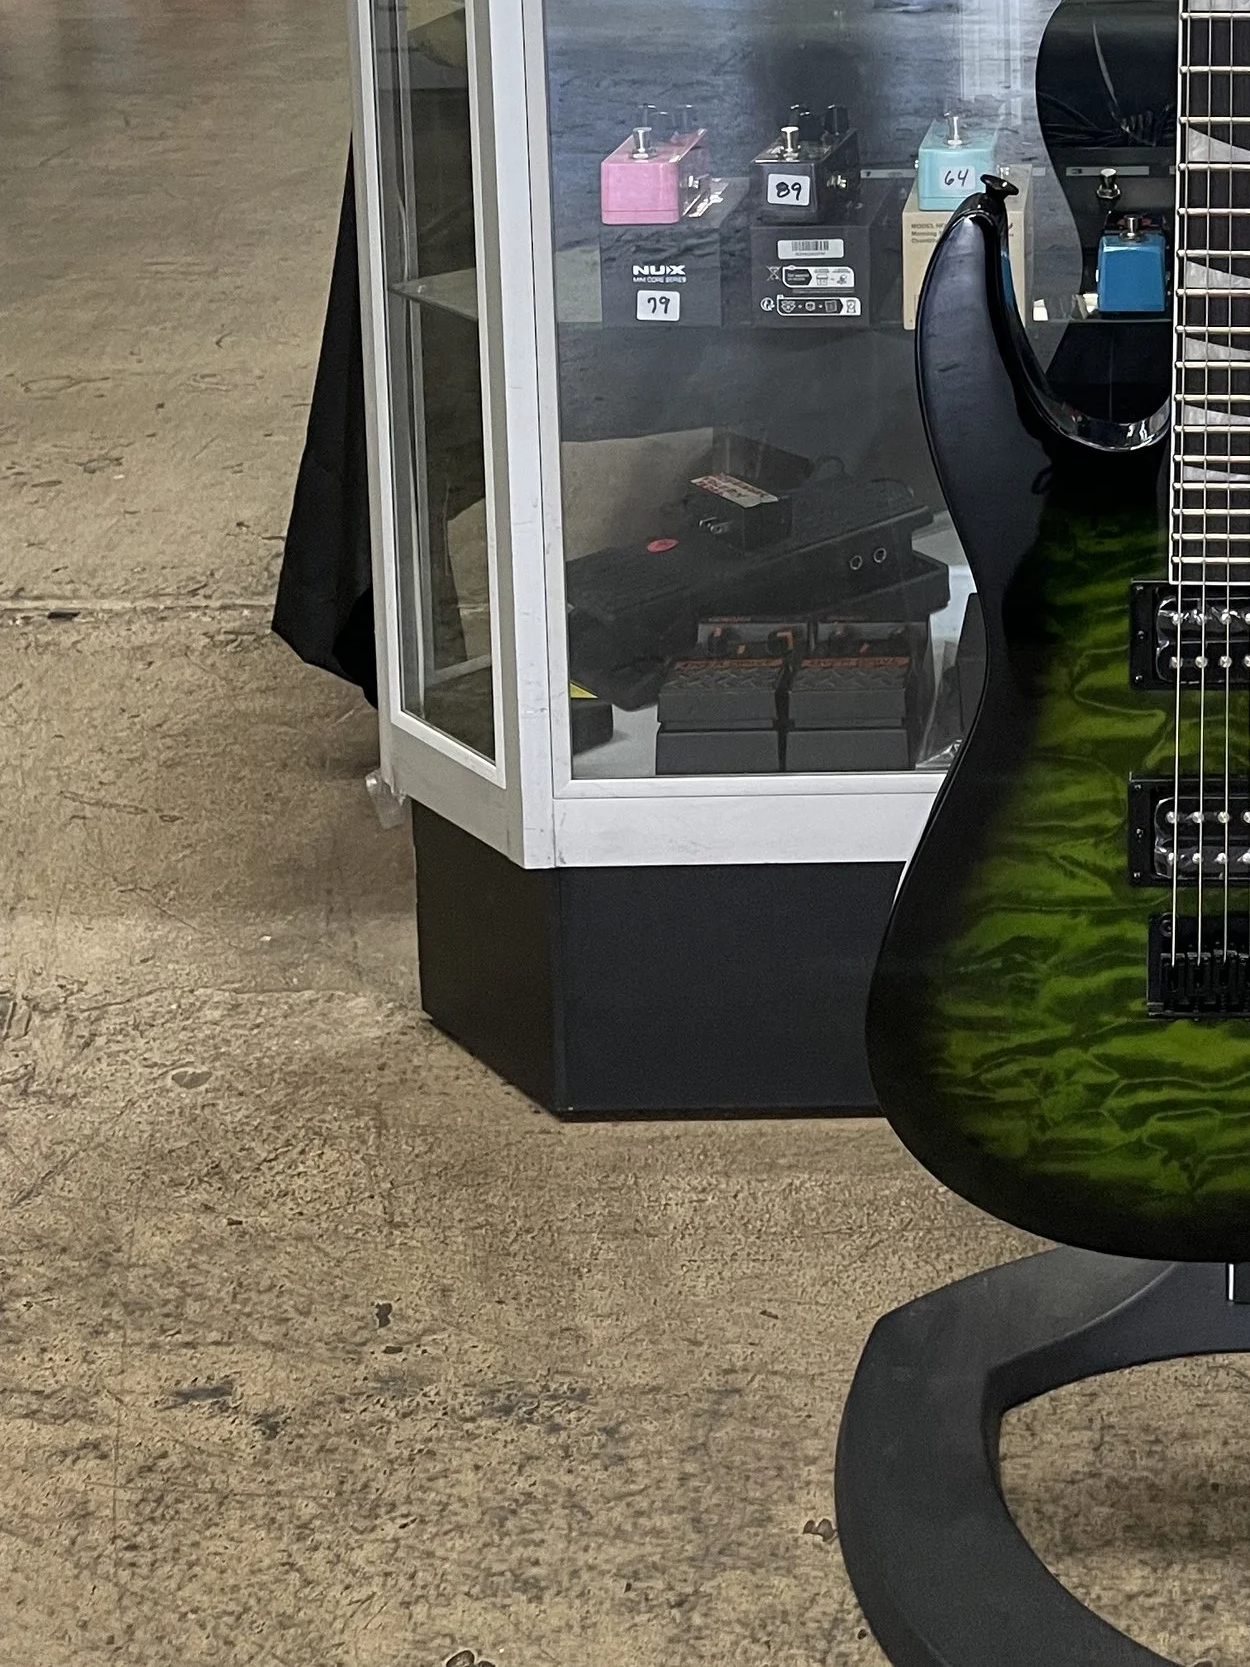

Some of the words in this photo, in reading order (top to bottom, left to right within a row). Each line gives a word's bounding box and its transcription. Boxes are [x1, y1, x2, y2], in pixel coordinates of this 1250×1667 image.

[944, 168, 969, 187] 64
[776, 181, 802, 201] 89
[632, 265, 686, 275] NUX
[647, 296, 671, 314] 79
